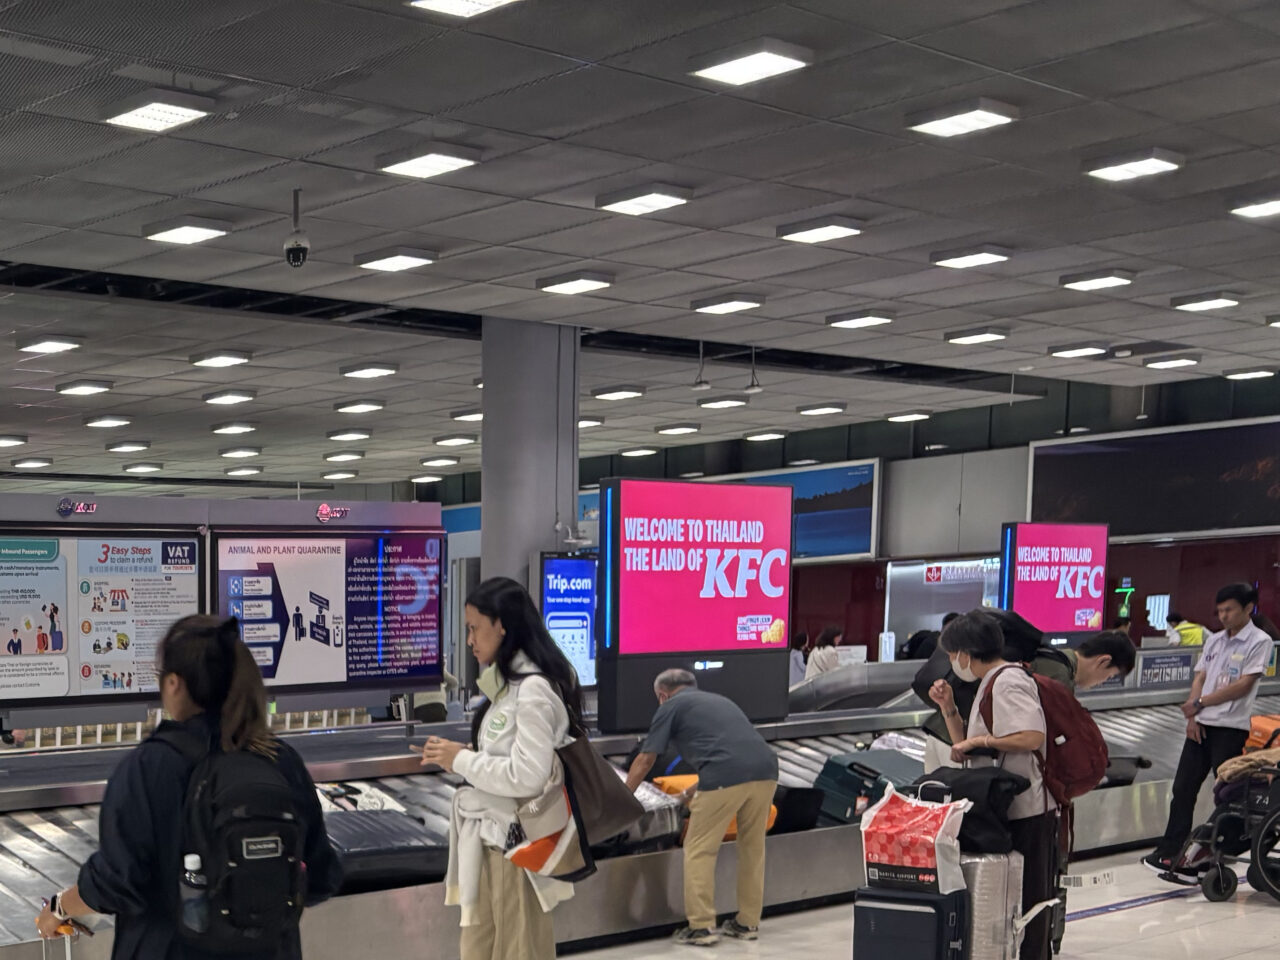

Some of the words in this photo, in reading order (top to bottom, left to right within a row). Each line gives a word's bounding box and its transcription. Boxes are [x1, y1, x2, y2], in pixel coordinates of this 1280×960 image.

[624, 517, 685, 542] WELCOME
[686, 519, 703, 542] TO
[705, 520, 764, 543] THAILAND
[97, 543, 110, 563] 3
[111, 546, 128, 556] Easy
[130, 546, 152, 555] Steps
[167, 546, 190, 558] VAT
[228, 546, 255, 554] ANIMAL
[256, 546, 272, 554] AND
[273, 546, 296, 554] PLANT
[297, 546, 341, 555] QUARANTINE
[1017, 546, 1050, 563] WELCOME
[1051, 547, 1061, 562] TO
[1060, 547, 1092, 563] THAILAND
[624, 547, 650, 571] THE
[651, 547, 686, 571] LAND
[687, 548, 703, 571] OF
[699, 548, 787, 598] KFC
[1017, 565, 1031, 581] THE
[1031, 565, 1049, 582] LAND
[1049, 565, 1059, 582] OF
[1055, 565, 1104, 599] KFC
[547, 574, 592, 594] Trip.com
[1255, 795, 1270, 805] 74
